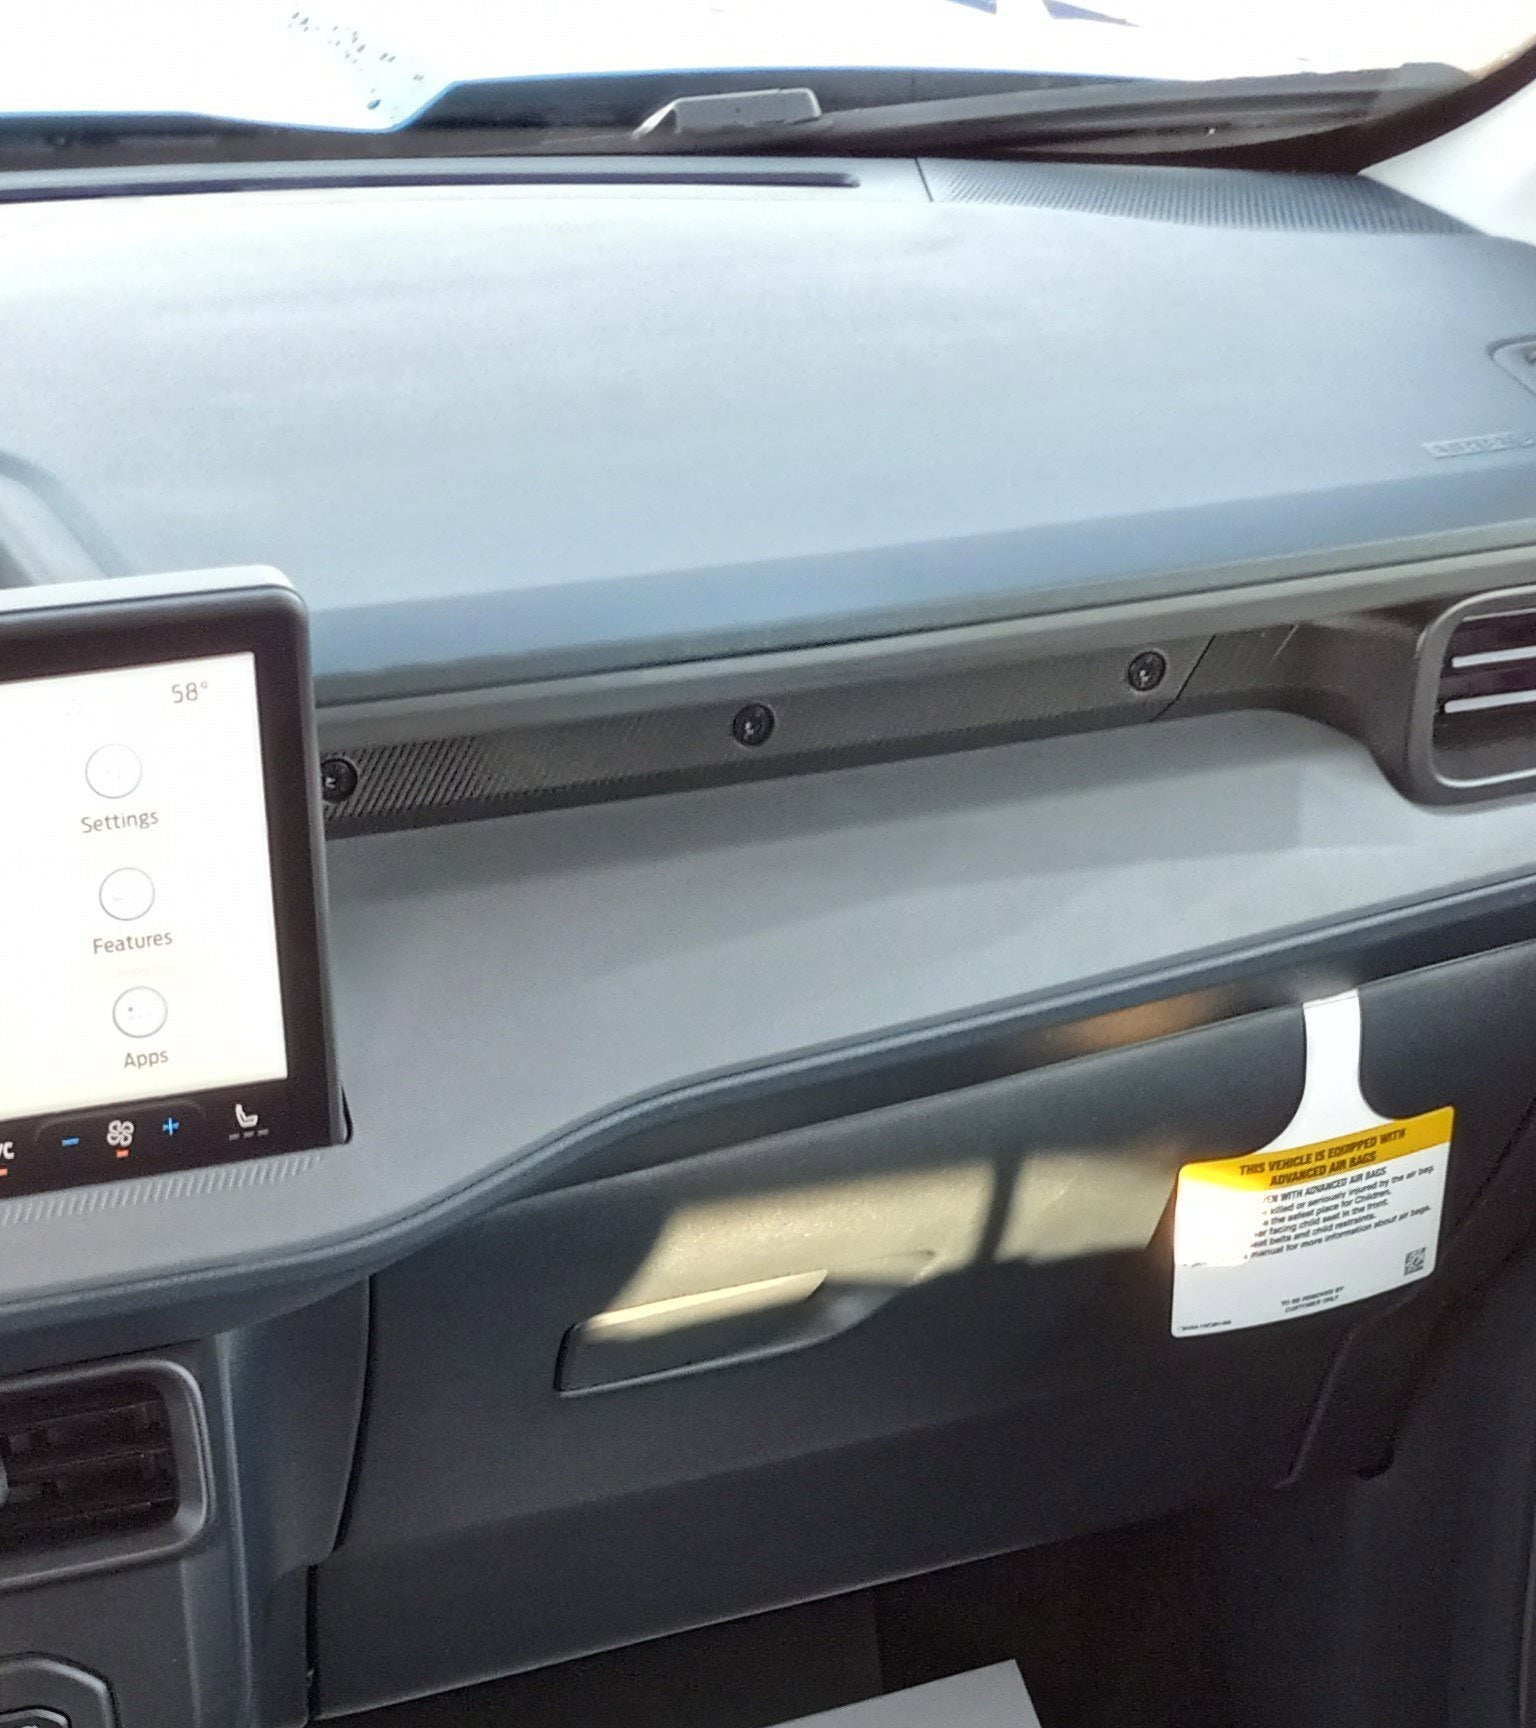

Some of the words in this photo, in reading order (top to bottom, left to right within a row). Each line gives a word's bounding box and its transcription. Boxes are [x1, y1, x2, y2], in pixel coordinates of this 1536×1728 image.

[170, 680, 210, 704] 58°
[80, 808, 159, 836] Settings
[92, 930, 174, 956] Features
[123, 1049, 170, 1070] Apps
[1240, 1160, 1266, 1176] THIS
[1268, 1151, 1314, 1172] VEHICLE
[1327, 1137, 1378, 1160] EQUIPPED
[1379, 1128, 1407, 1145] WITH
[1270, 1165, 1327, 1187] ADVANCED
[1328, 1158, 1348, 1174] AIR
[1349, 1151, 1377, 1168] BAGS
